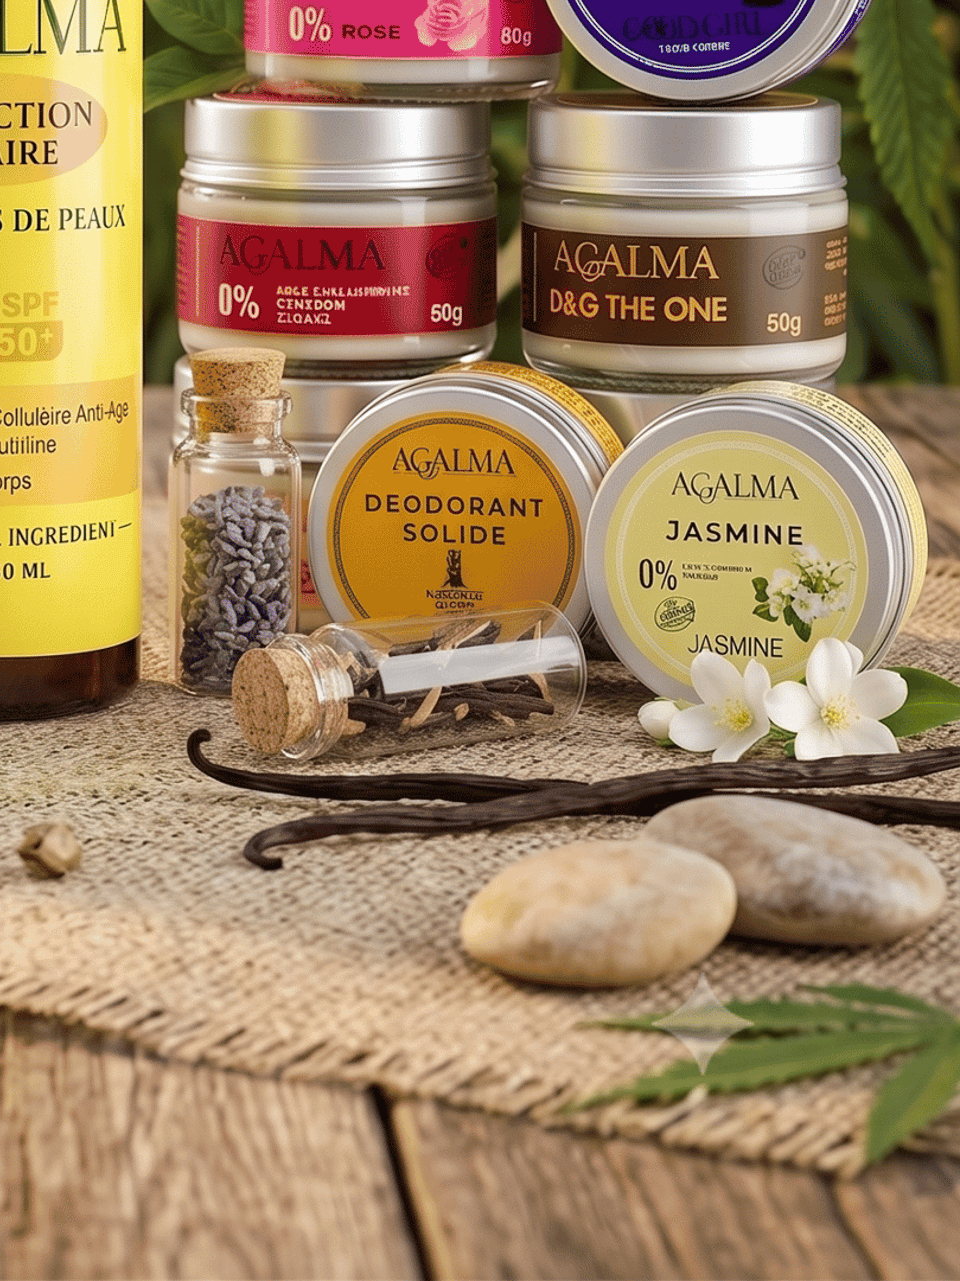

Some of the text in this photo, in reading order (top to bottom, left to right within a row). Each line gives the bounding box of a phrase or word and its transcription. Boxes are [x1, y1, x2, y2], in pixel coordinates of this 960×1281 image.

[289, 6, 401, 42] 0% ROSE
[12, 208, 50, 232] DE
[58, 204, 126, 231] PEAUX
[220, 234, 386, 277] AGALMA
[554, 239, 720, 282] AGALMA
[2, 291, 59, 317] SPF
[218, 283, 260, 319] 0%
[550, 288, 728, 322] D&G THE ONE
[766, 312, 801, 336] 50g
[75, 401, 129, 424] Anti-Age
[392, 447, 516, 480] AGALMA
[672, 471, 800, 504] AGALMA
[365, 493, 544, 518] DEODORANT
[403, 523, 506, 546] SOLIDE
[665, 520, 803, 546] JASMINE
[22, 562, 51, 580] ML
[639, 558, 677, 591] 0%
[687, 634, 784, 658] JASMINE
